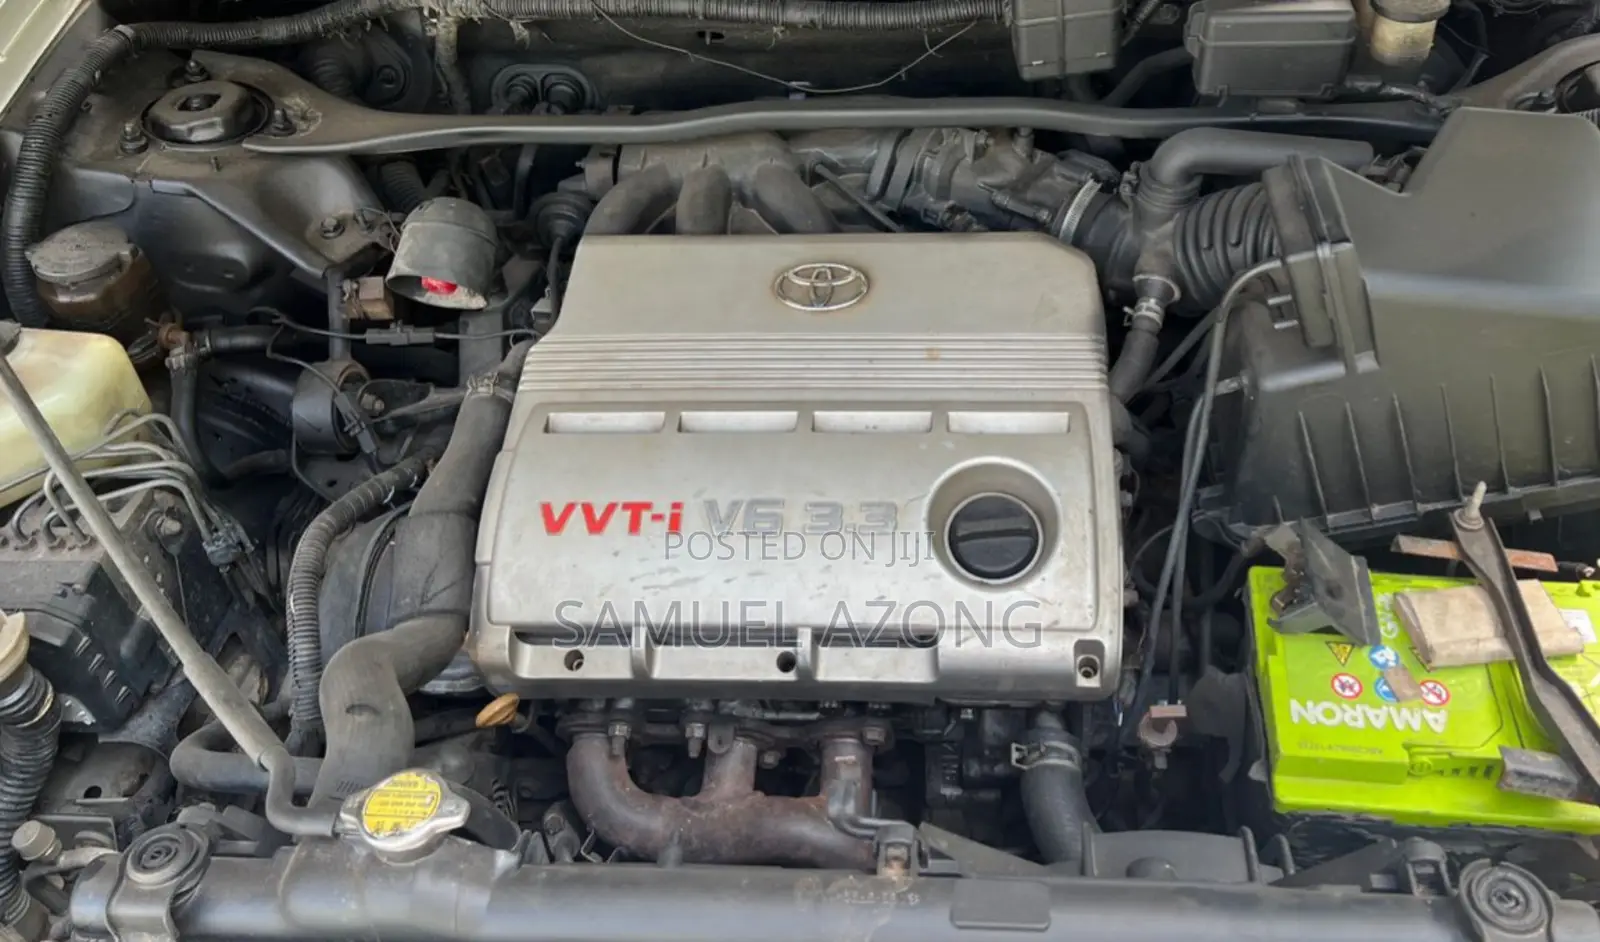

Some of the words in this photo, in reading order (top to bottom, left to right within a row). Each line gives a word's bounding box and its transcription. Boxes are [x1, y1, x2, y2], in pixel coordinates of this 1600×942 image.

[540, 501, 683, 536] VVT-i
[703, 499, 785, 537] V6
[803, 500, 899, 537] 3.3
[1290, 699, 1448, 733] AMARON
